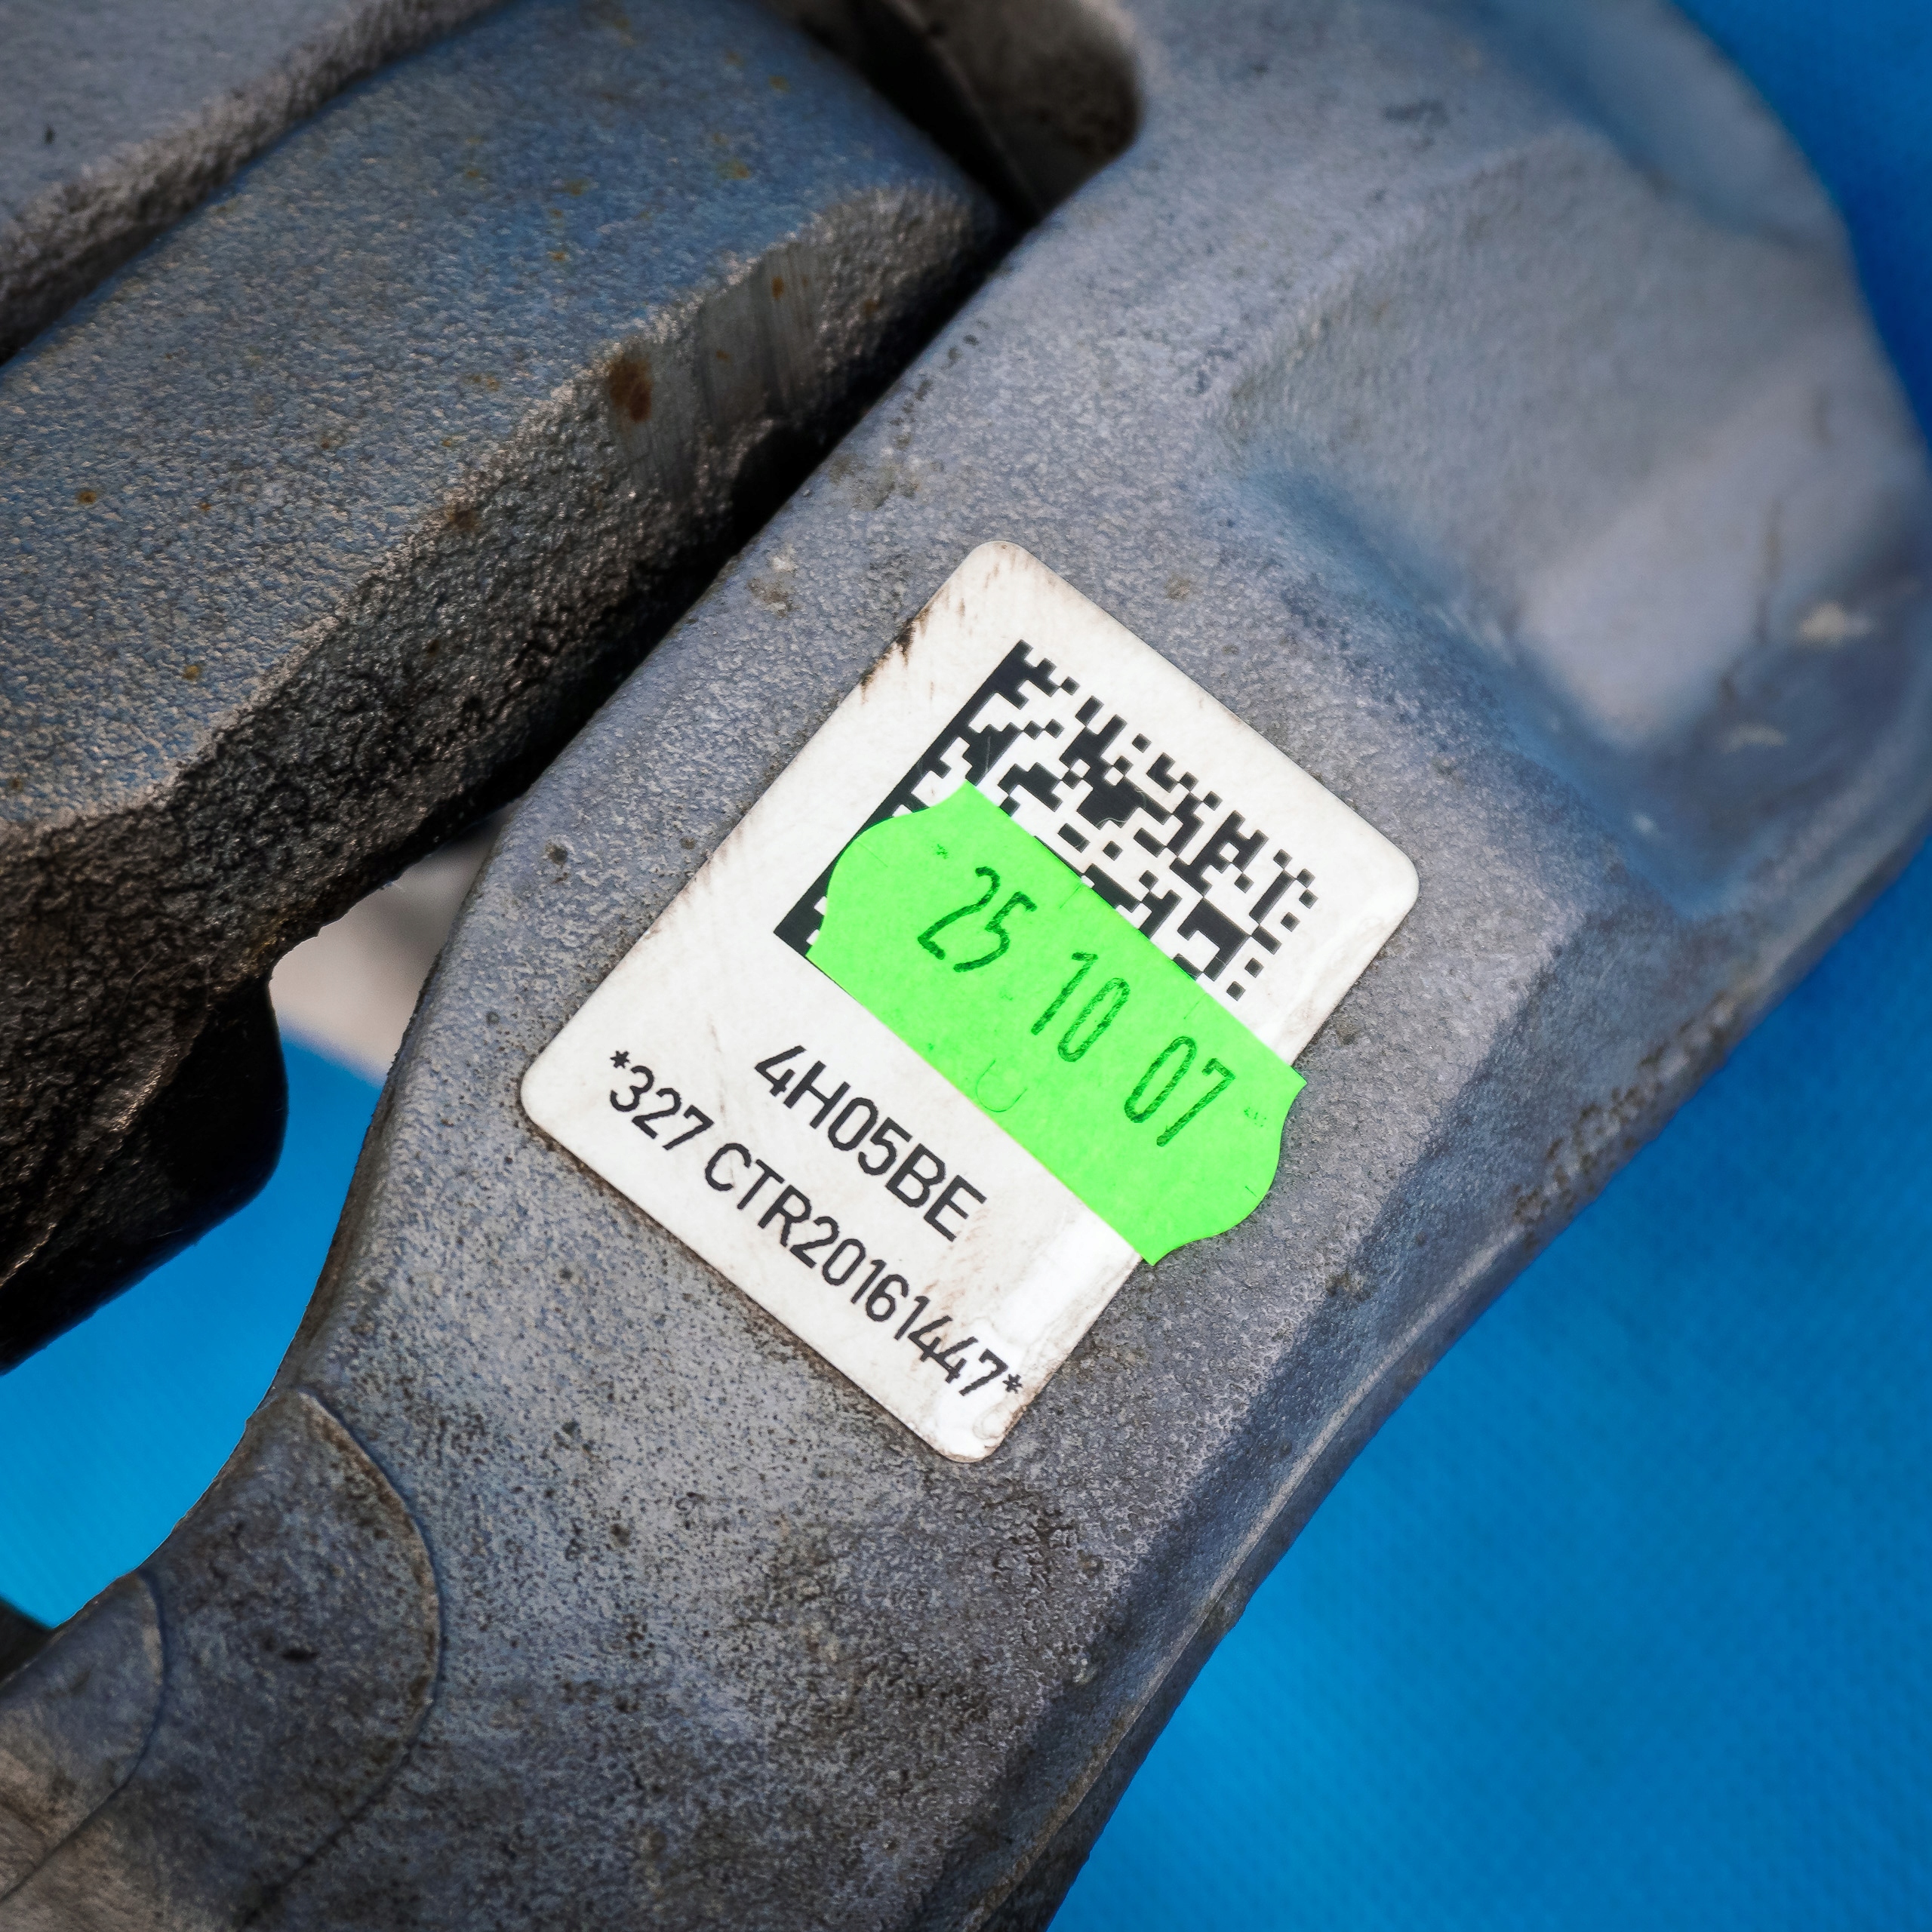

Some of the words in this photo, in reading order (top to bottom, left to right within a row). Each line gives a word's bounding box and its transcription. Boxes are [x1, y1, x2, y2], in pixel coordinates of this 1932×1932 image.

[918, 866, 1037, 972] 25
[1031, 952, 1131, 1063] 10
[1124, 1036, 1236, 1148] 07
[754, 1044, 987, 1242] 4H05BE
